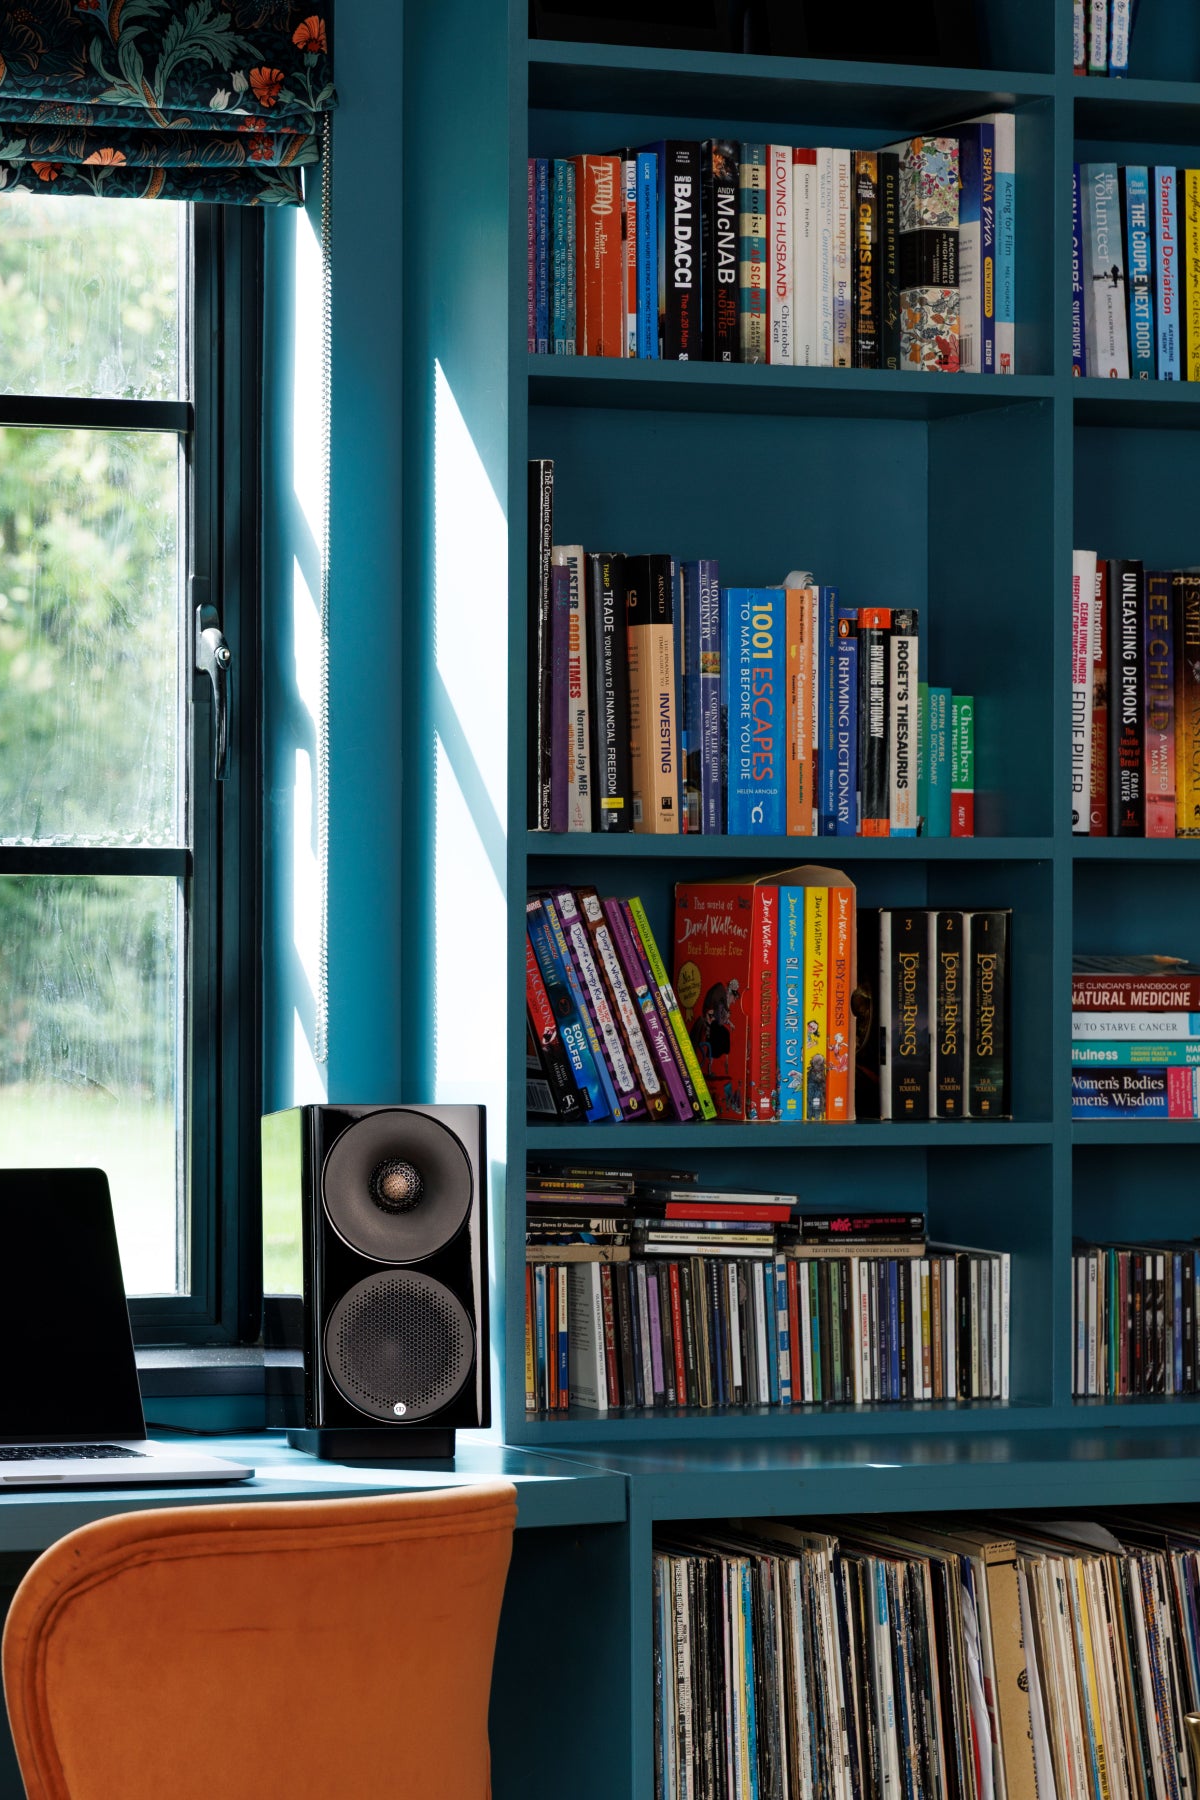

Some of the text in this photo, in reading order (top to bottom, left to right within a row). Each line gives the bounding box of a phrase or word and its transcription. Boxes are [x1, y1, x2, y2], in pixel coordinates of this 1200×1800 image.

[589, 162, 613, 215] TATTOO
[751, 168, 762, 235] tattooist
[982, 148, 994, 202] ESPAÑA
[674, 183, 692, 288] BALDACCI
[718, 194, 735, 284] McNAB
[776, 160, 786, 296] LOVING HUSBAND
[1003, 182, 1014, 256] Acting for Film
[1161, 176, 1174, 314] Standard Deviation
[750, 249, 760, 318] AUSCHWITZ
[859, 204, 872, 315] CHRIS RYAN
[1132, 203, 1150, 358] THE COUPLE NEXT DOOR
[781, 305, 790, 358] Christobel
[542, 470, 552, 572] The Complete Guitar Player
[566, 557, 581, 698] MISTER GOOD TIMES
[603, 590, 615, 632] TRADE
[604, 636, 612, 656] YOUR
[1122, 573, 1136, 724] UNLEASHING DEMONS
[606, 678, 613, 688] TO
[740, 602, 750, 780] TO MAKE BEFORE YOU DIE
[752, 602, 774, 780] 1001 ESCAPES
[870, 645, 884, 738] RHYMING DICTIONARY
[606, 690, 616, 744] FINANCIAL
[659, 692, 672, 773] INVESTING
[838, 657, 850, 824] RHYMING DICTIONARY
[896, 640, 908, 788] ROGET'S THESAURUS
[960, 704, 972, 782] Chambers
[606, 747, 618, 794] FREEDOM
[812, 960, 823, 1010] Mr Stink
[899, 952, 919, 992] LORD
[977, 953, 997, 993] LORD
[1086, 982, 1132, 990] CLINICIAN'S
[1130, 992, 1190, 1006] MEDICINE
[572, 1023, 587, 1051] EOIN
[784, 957, 798, 1066] BILLIONAIRE BOY
[900, 1004, 918, 1056] RINGS
[977, 1006, 994, 1056] RINGS
[1100, 1023, 1136, 1031] STARVE
[1139, 1023, 1178, 1031] CANCER
[562, 1027, 583, 1070] COLFER
[648, 1016, 671, 1062] THE SWITCH
[1112, 1093, 1165, 1106] Wisdom
[1124, 1076, 1164, 1090] Bodies
